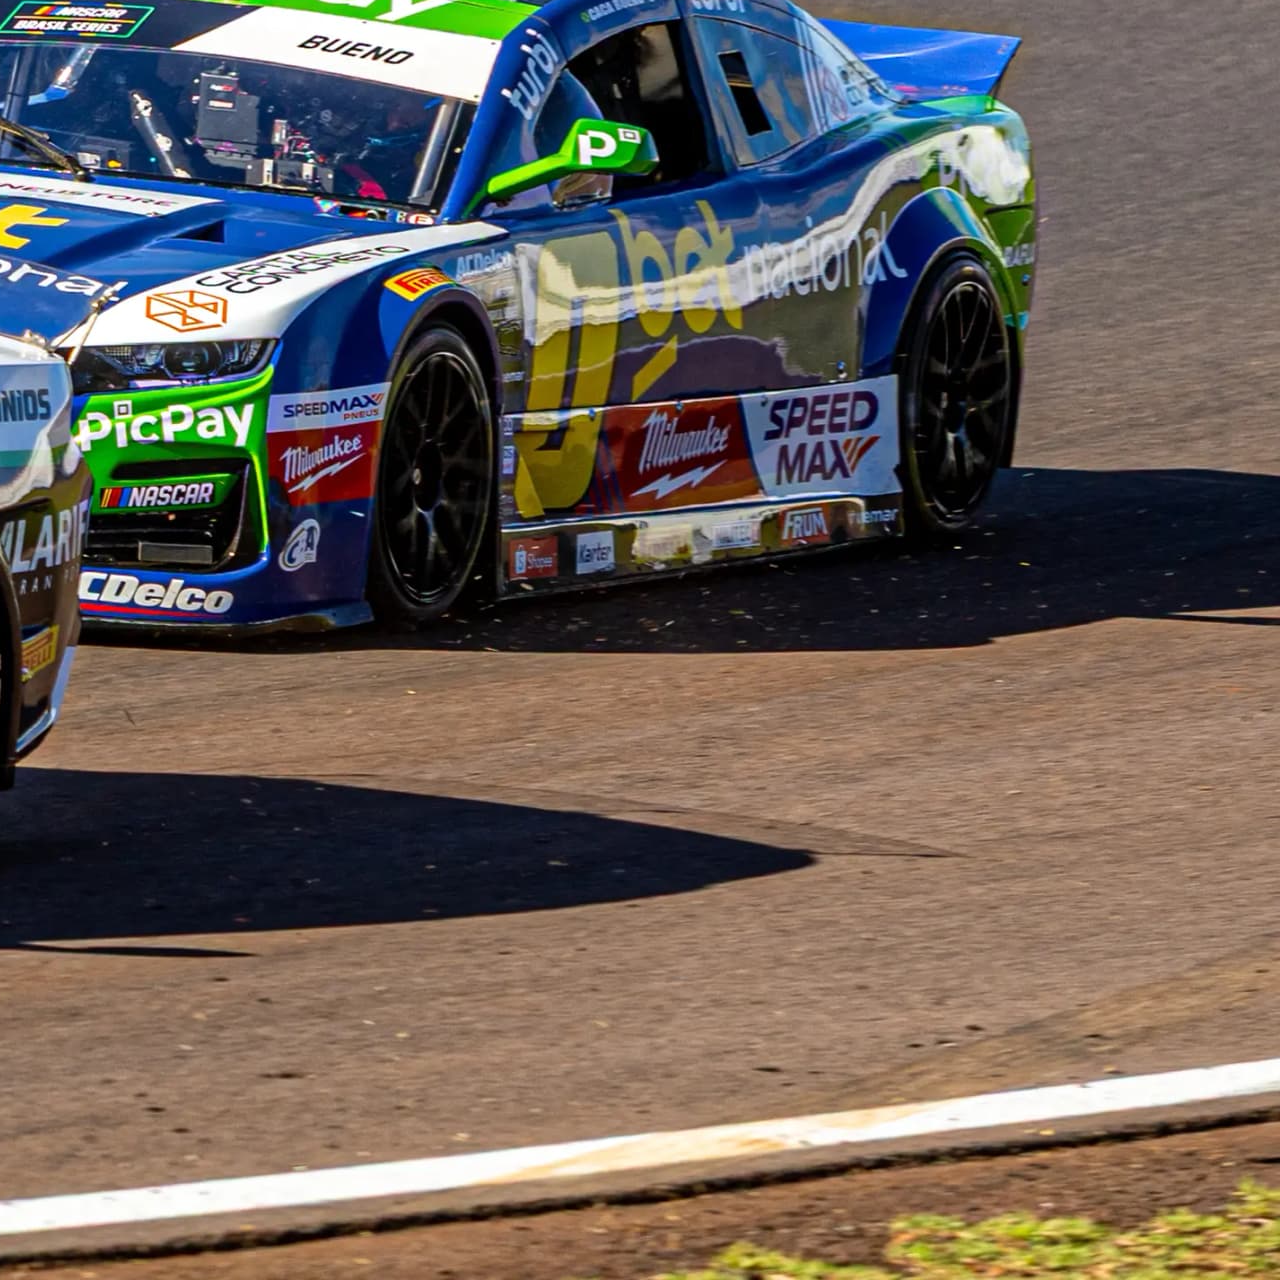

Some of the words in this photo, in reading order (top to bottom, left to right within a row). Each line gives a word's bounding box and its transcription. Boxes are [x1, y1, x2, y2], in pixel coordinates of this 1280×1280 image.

[14, 20, 69, 32] BRASIL
[68, 21, 123, 34] SERIES
[56, 6, 129, 19] NASCAR
[297, 34, 416, 66] BUENO
[224, 244, 411, 294] CONCRETO
[74, 399, 254, 451] PicPay
[763, 391, 879, 441] SPEED
[279, 434, 364, 483] Milwaukee
[639, 408, 730, 474] Milwaukee
[775, 437, 852, 486] MAX
[128, 482, 215, 507] NASCAR
[782, 508, 830, 539] FRUM
[578, 542, 613, 564] Karter
